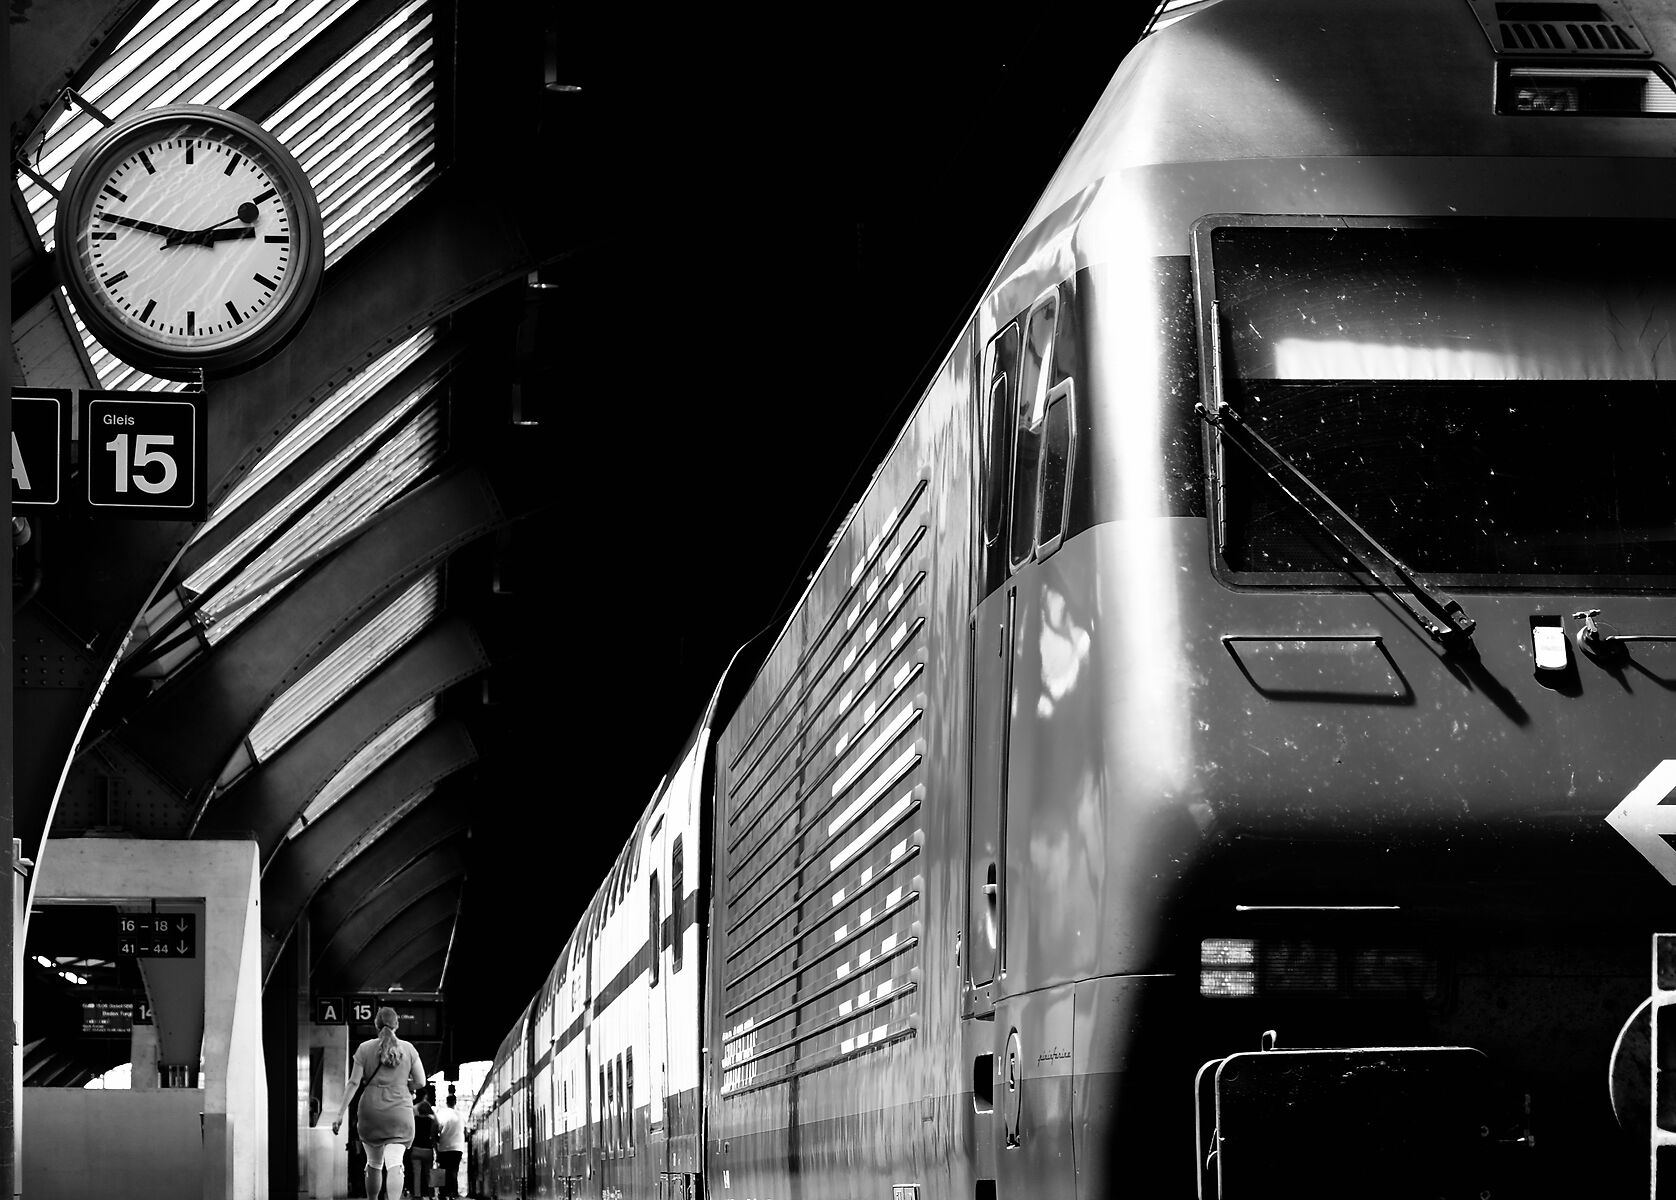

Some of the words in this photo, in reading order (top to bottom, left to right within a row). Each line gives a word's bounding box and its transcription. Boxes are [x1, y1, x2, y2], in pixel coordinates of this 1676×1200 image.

[103, 414, 135, 425] Gleis
[106, 433, 178, 494] 15
[121, 920, 135, 932] 16
[154, 920, 168, 932] 18
[121, 943, 135, 954] 41
[153, 944, 169, 954] 44
[324, 1005, 337, 1020] A
[353, 1004, 372, 1020] 15
